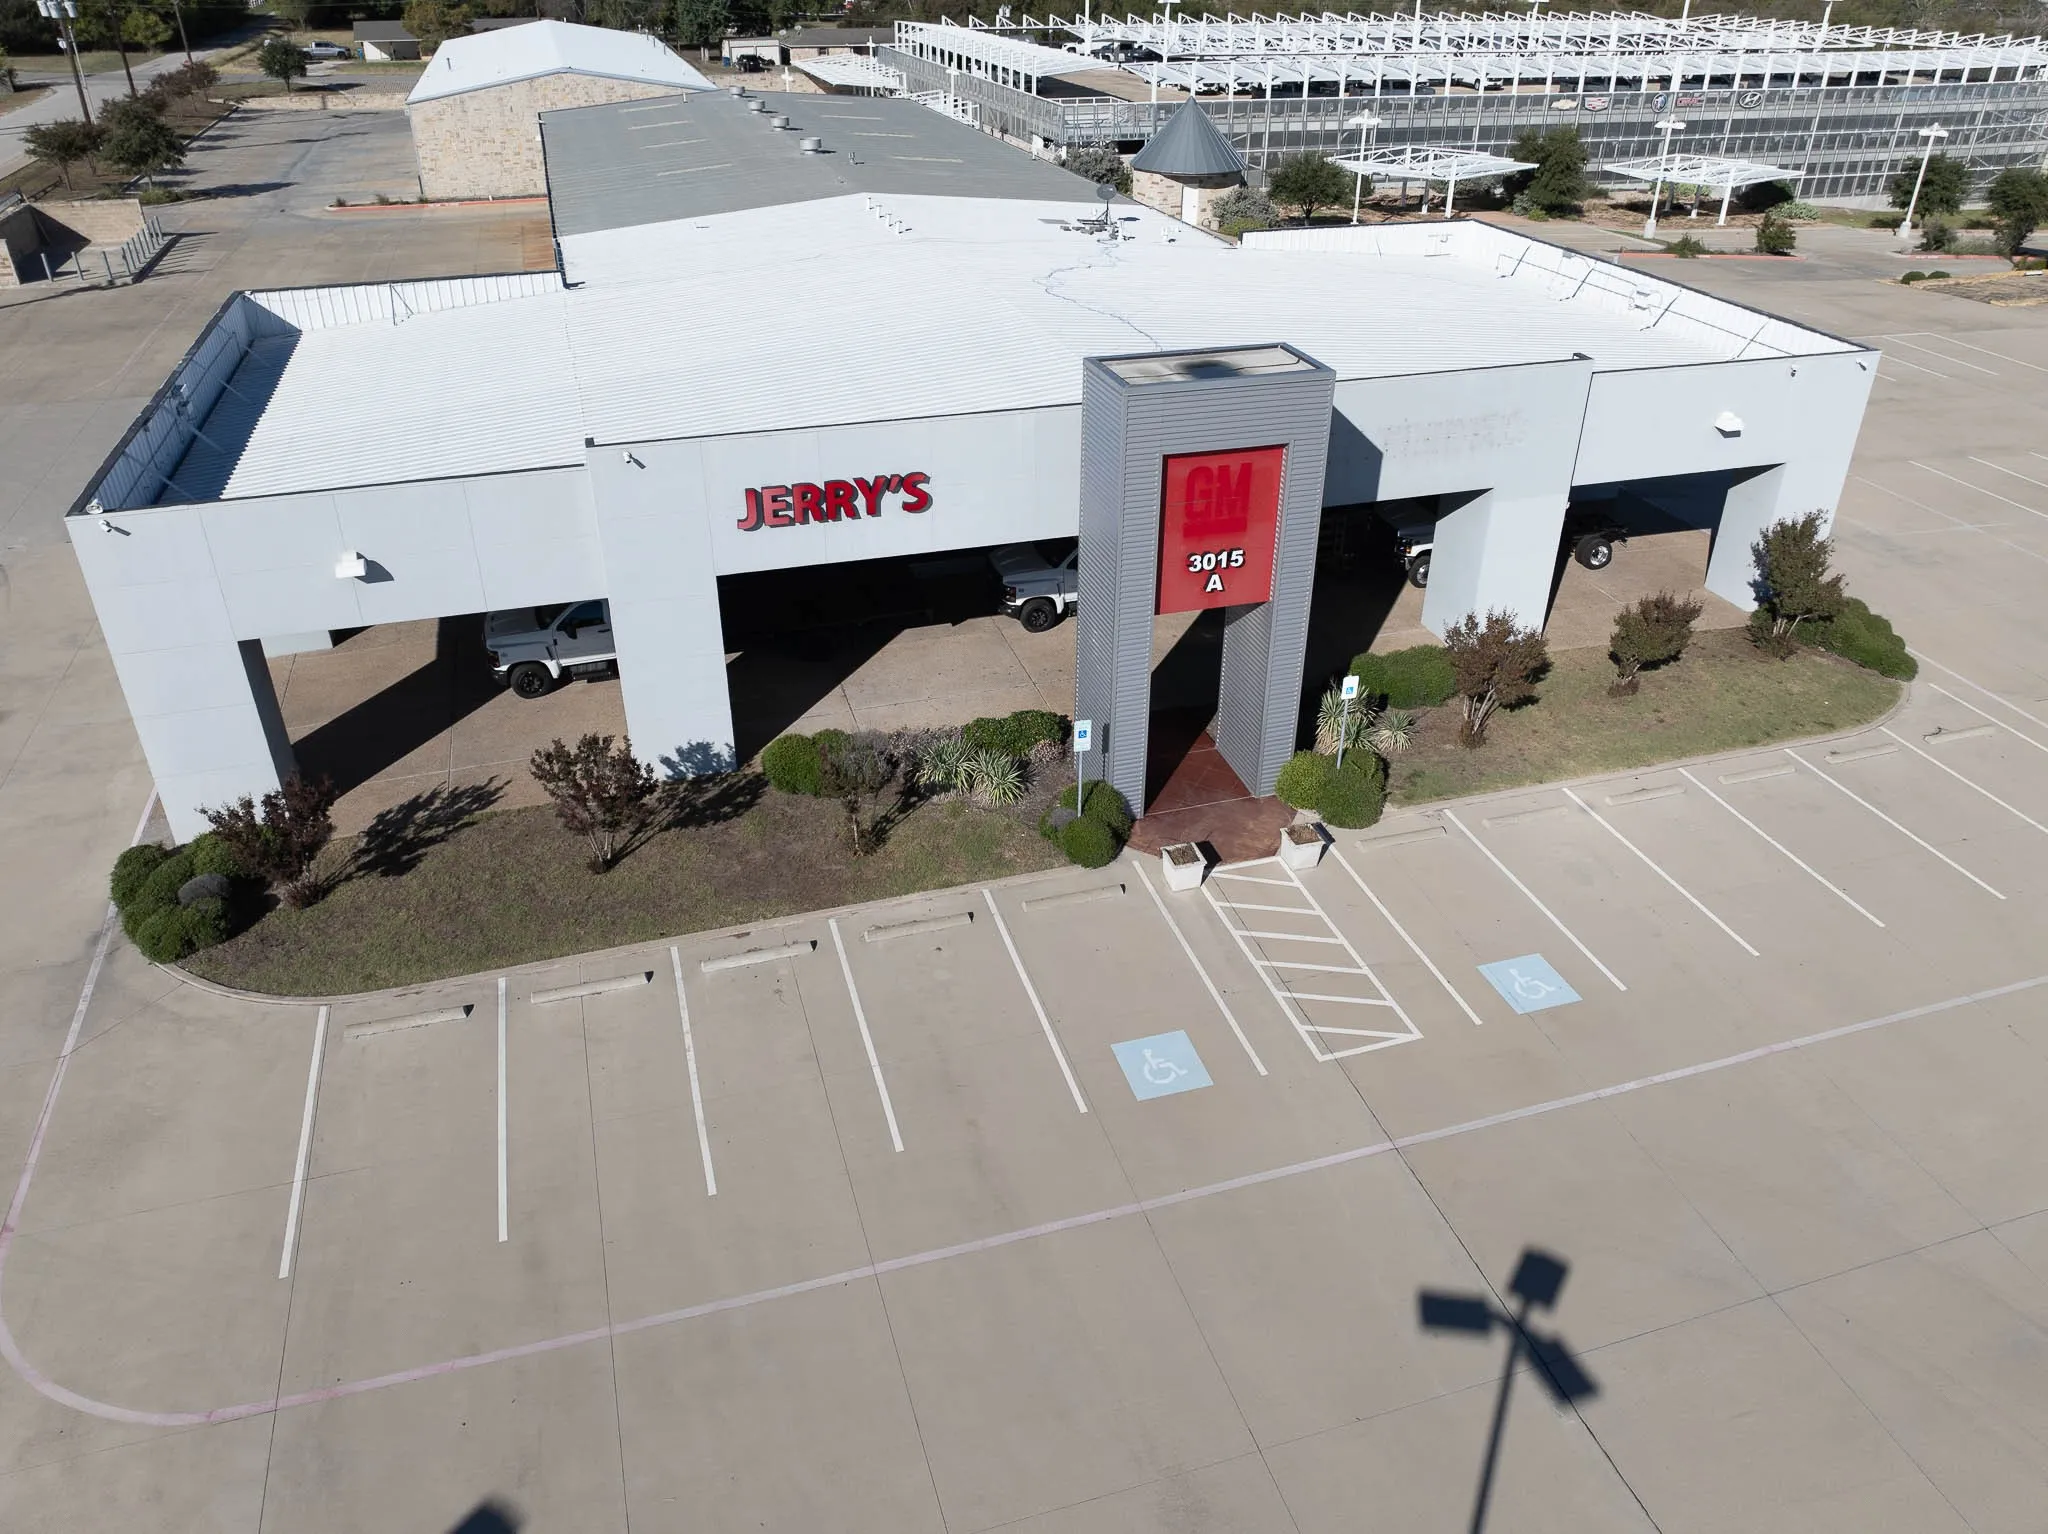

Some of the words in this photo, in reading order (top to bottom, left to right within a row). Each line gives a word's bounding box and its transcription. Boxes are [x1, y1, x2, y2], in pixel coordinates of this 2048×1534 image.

[737, 472, 933, 531] JERRY'S
[1185, 462, 1253, 520] GM
[1187, 548, 1245, 573] 3015
[1204, 573, 1224, 592] A
